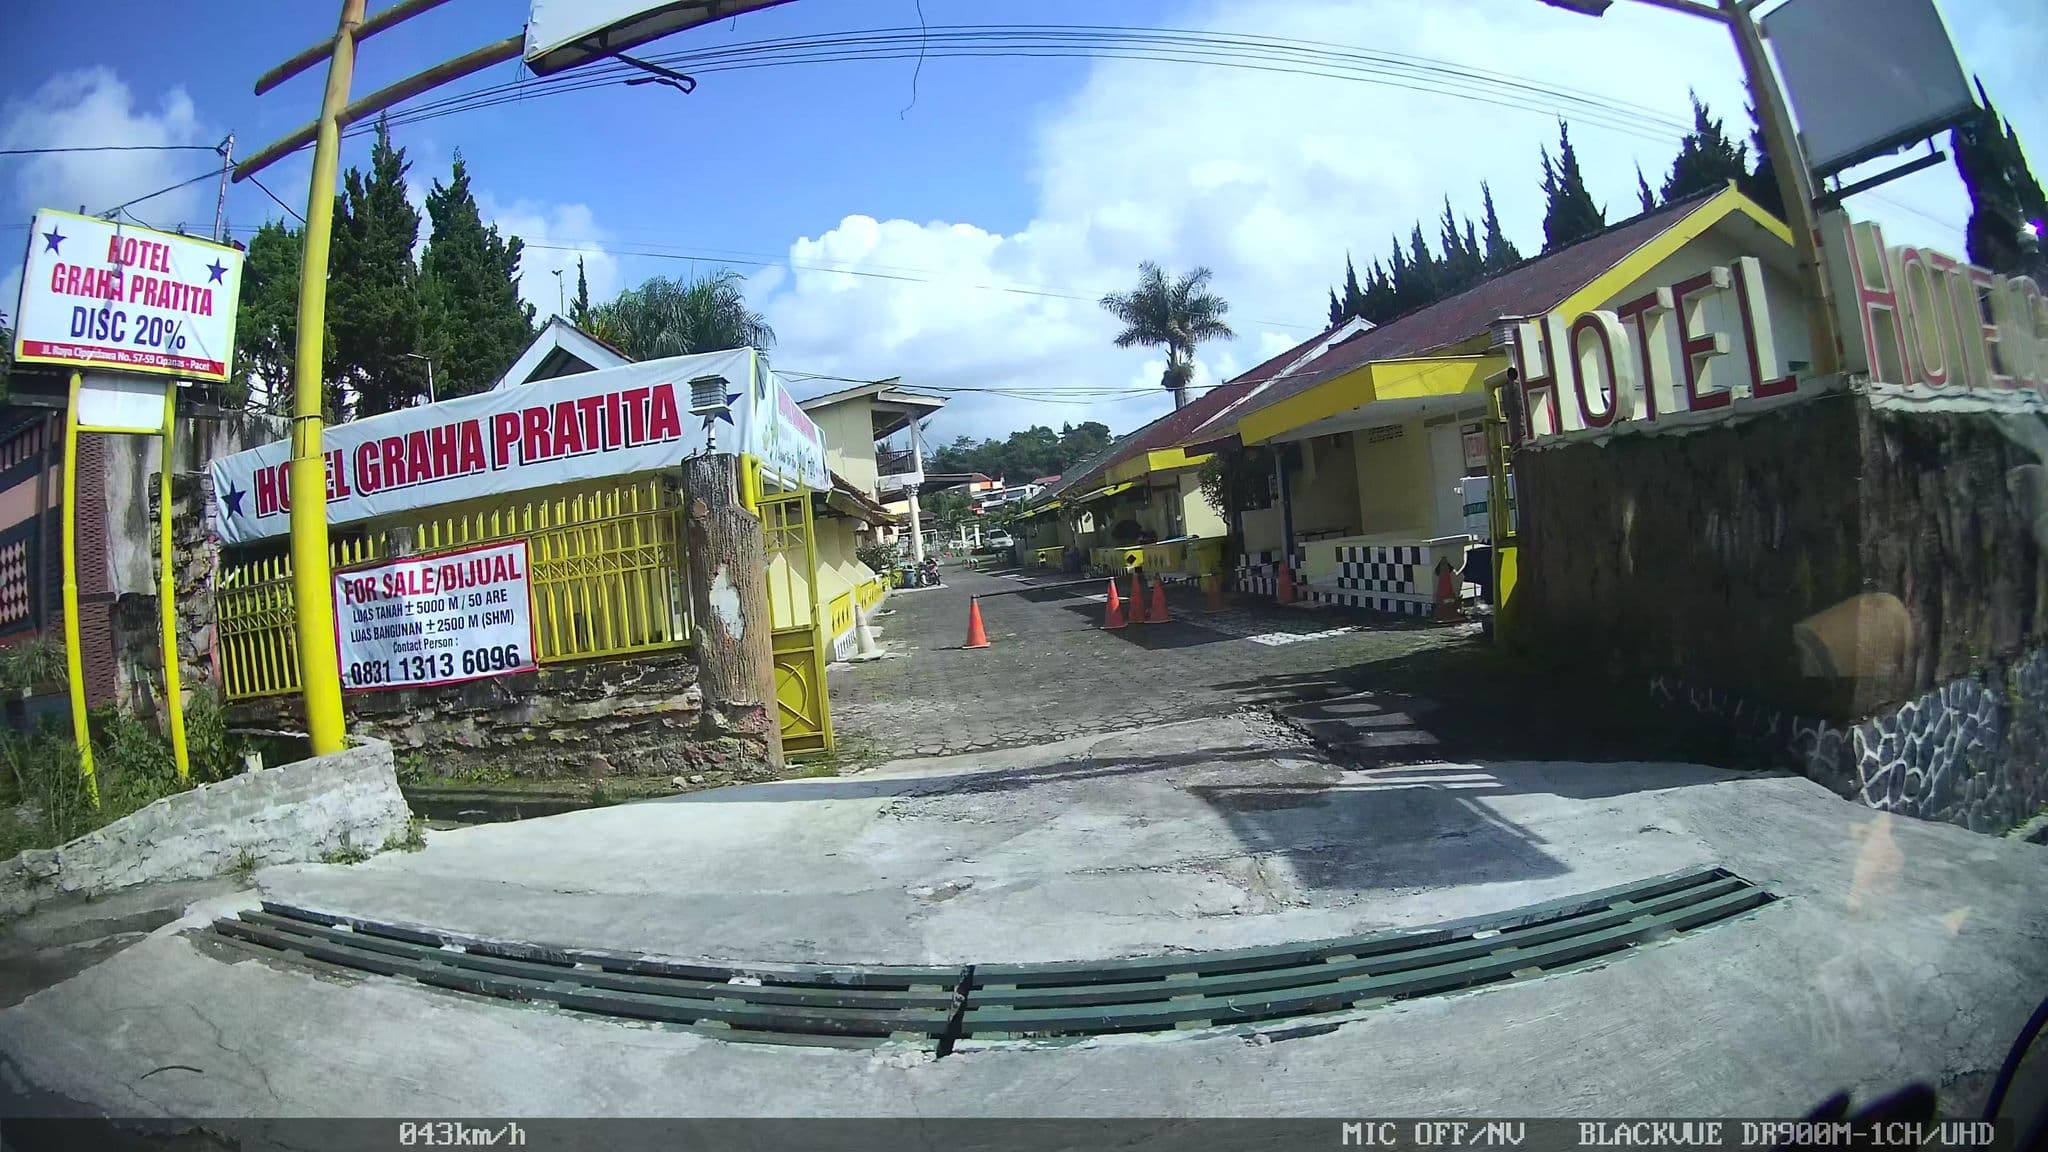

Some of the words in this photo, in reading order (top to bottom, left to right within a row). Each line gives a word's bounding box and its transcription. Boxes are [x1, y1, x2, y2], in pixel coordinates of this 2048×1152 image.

[107, 234, 171, 274] HOTEL
[51, 262, 124, 302] GRAHA
[129, 274, 213, 316] PRATITA
[70, 305, 127, 343] DISC
[134, 314, 187, 350] 20%
[1513, 256, 1798, 440] HOTEL
[118, 351, 131, 362] No.
[254, 449, 351, 519] HOEL
[355, 418, 487, 496] GRAHA
[490, 383, 682, 471] PRATITA
[344, 576, 378, 605] FOR
[382, 553, 522, 599] SALE/DIJUAL
[351, 628, 372, 643] LUAS
[374, 622, 423, 640] BANGUNAN
[468, 614, 479, 628] M
[482, 609, 515, 630] (SHM)
[353, 609, 374, 623] LUAS
[375, 604, 403, 620] TANAH
[448, 596, 459, 611] M
[468, 593, 483, 608] 50
[485, 589, 508, 605] ARE
[351, 659, 391, 685] 0831
[399, 652, 454, 681] 1313
[462, 644, 521, 675] 6096
[393, 639, 422, 654] Contact
